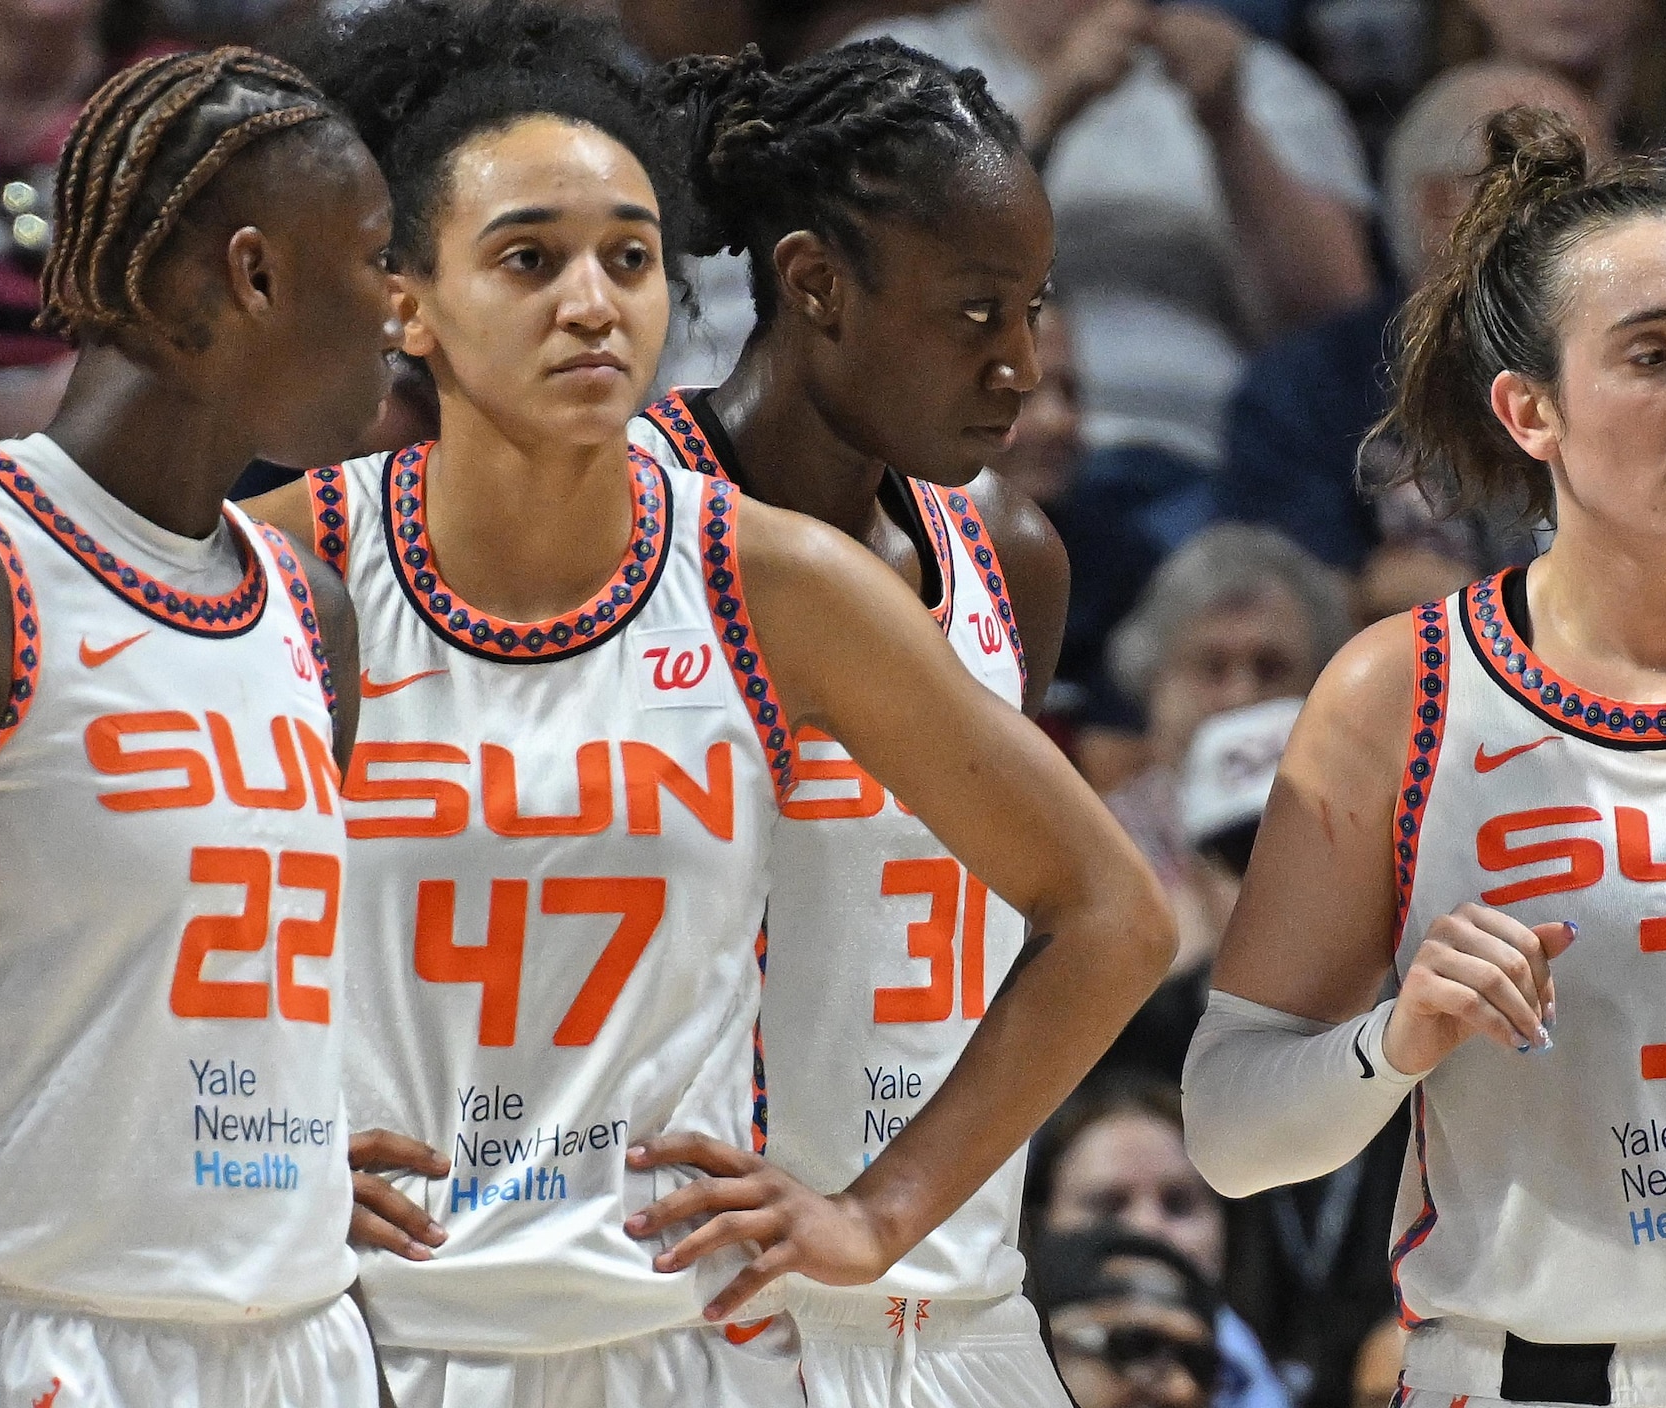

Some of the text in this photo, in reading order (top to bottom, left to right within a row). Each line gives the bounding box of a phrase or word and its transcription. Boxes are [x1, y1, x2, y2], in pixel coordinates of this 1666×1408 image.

[85, 710, 341, 815] SUN
[341, 740, 735, 841] SUN
[169, 847, 342, 1025] 22
[873, 857, 988, 1024] 31
[414, 876, 668, 1048] 47
[189, 1059, 256, 1097] Yale
[864, 1065, 922, 1101] Yale
[457, 1085, 524, 1122] Yale
[454, 1119, 629, 1168] NewHaven
[194, 1150, 299, 1190] Health
[451, 1166, 568, 1214] Health
